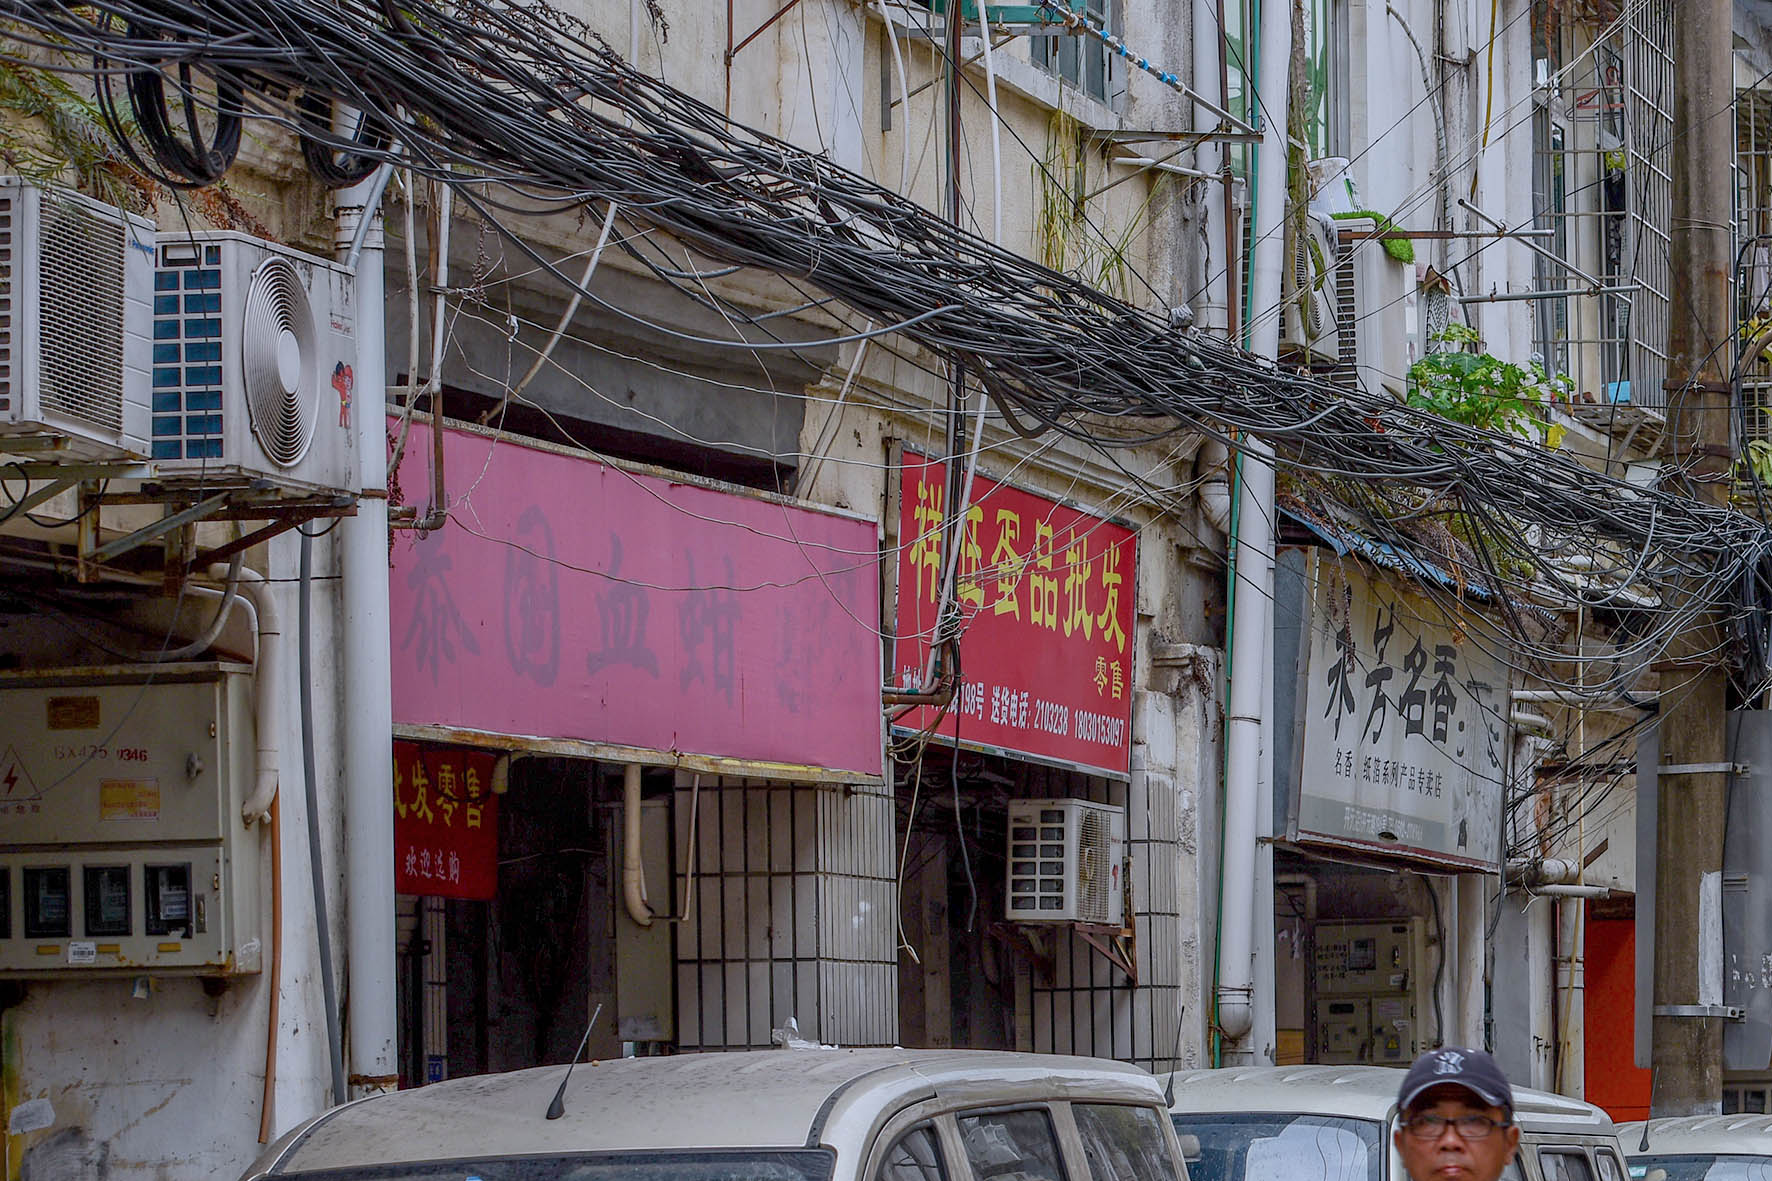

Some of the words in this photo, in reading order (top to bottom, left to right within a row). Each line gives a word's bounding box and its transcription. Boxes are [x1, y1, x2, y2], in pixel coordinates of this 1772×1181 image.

[1093, 656, 1124, 700] 零售
[1034, 699, 1069, 736] 2103238
[1074, 709, 1125, 748] 18030153097
